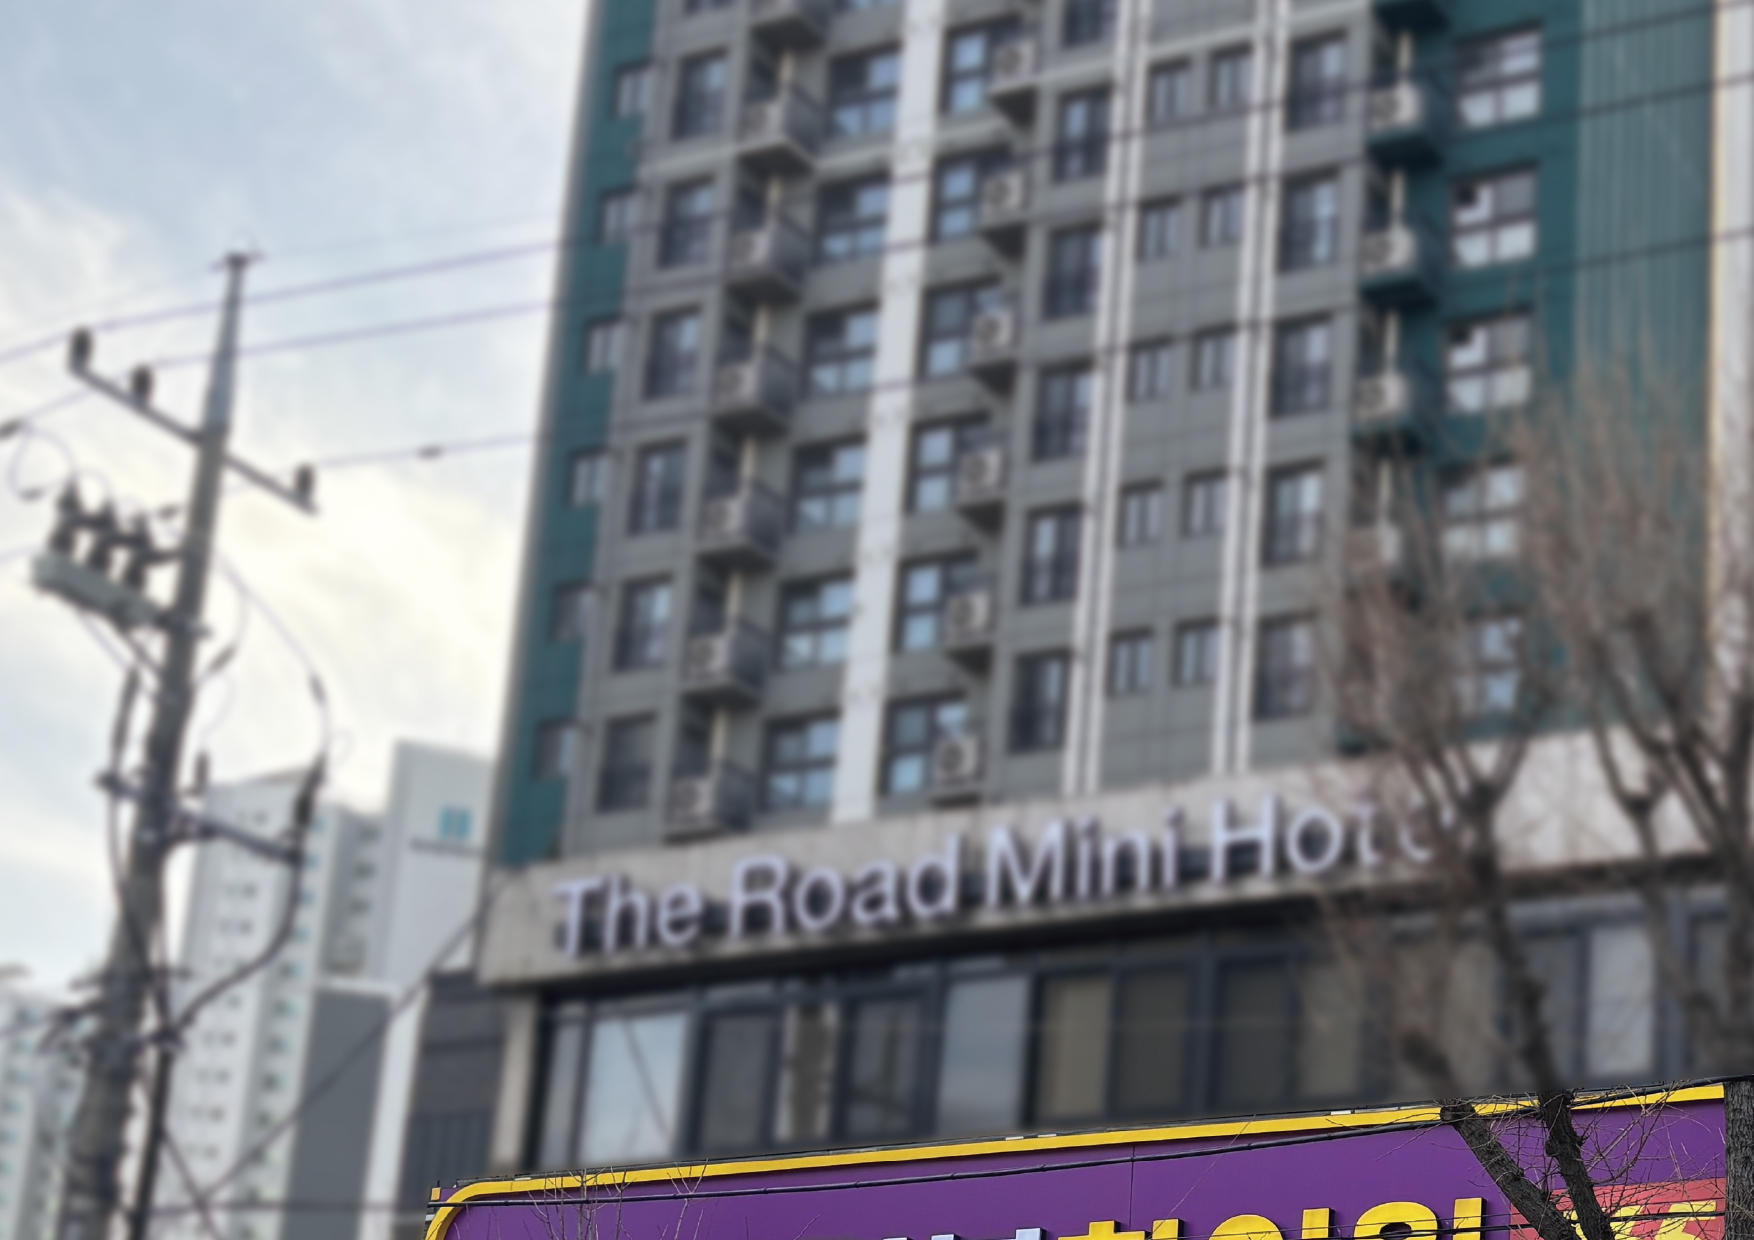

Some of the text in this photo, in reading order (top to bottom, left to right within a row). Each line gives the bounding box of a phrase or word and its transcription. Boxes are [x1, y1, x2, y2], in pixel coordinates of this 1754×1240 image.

[555, 875, 703, 960] The
[726, 838, 961, 940] Road
[982, 806, 1184, 910] Mini
